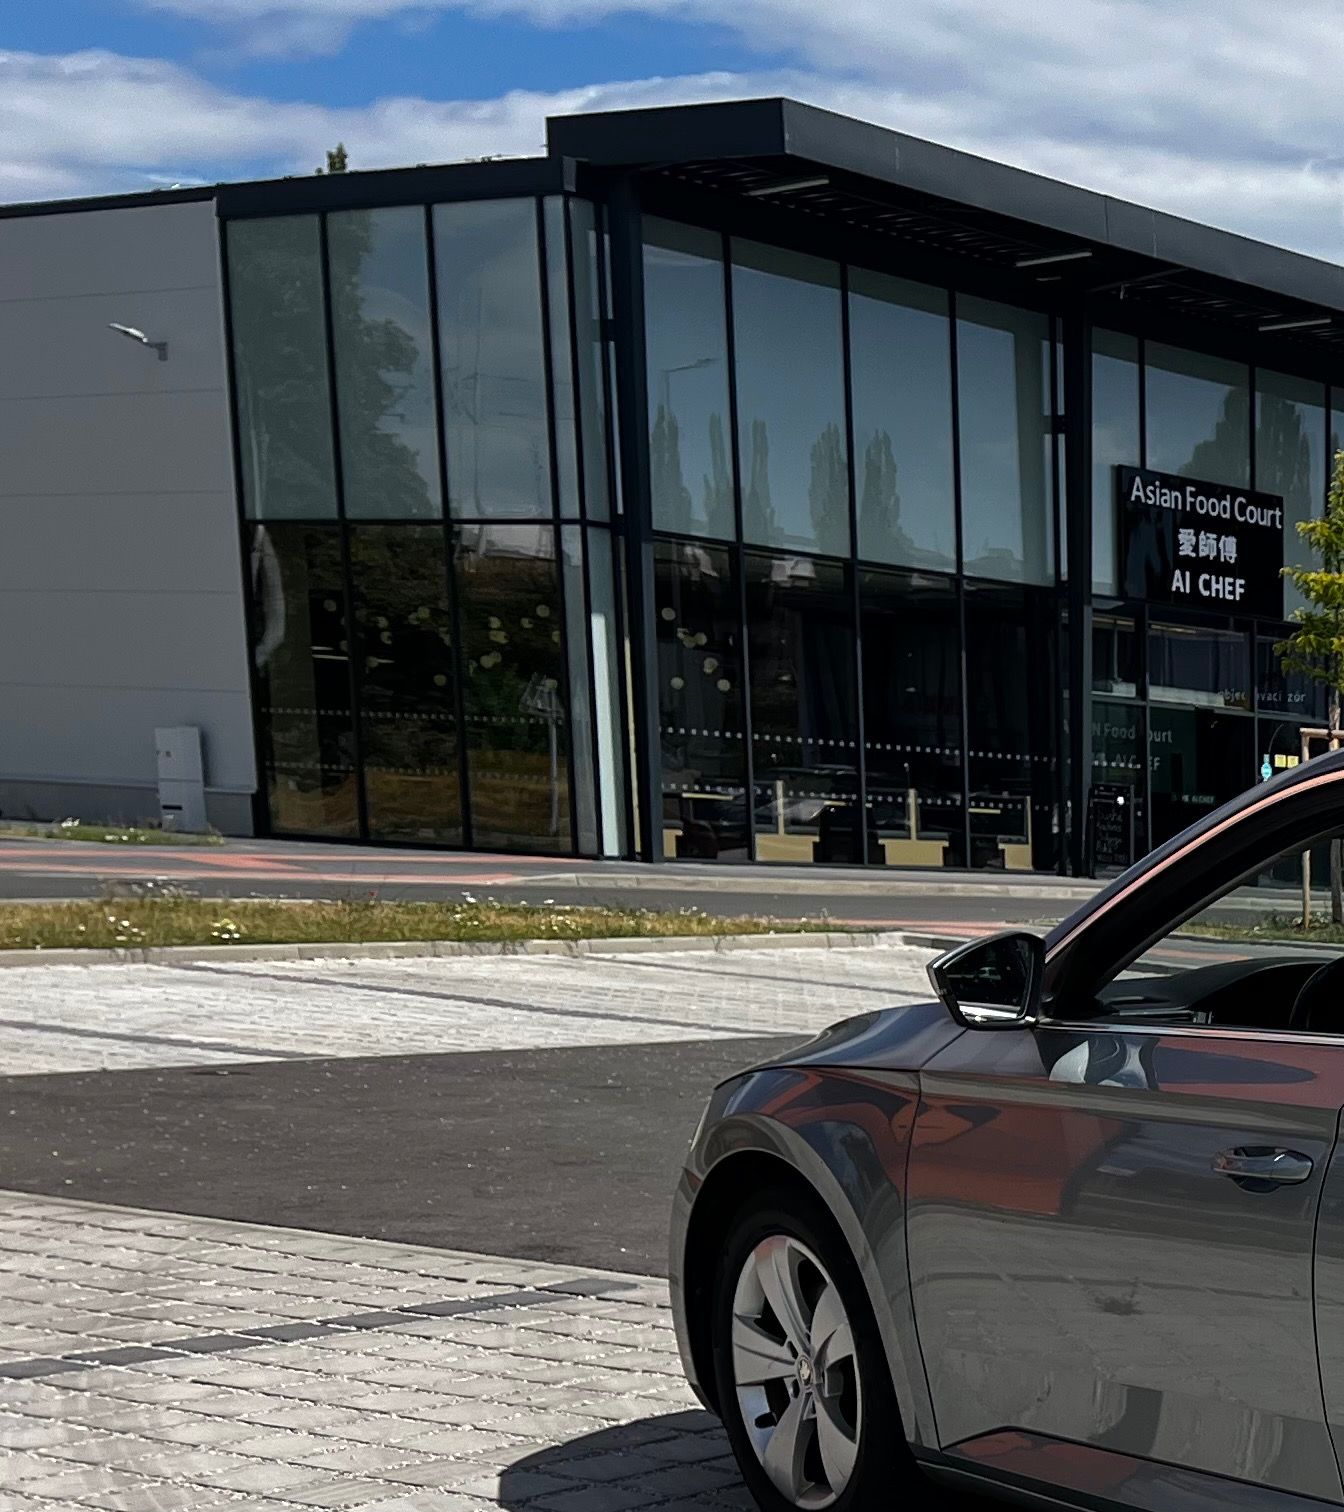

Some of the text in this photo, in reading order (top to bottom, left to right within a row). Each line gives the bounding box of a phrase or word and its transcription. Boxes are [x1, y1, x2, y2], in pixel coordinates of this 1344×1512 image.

[1131, 476, 1282, 529] Asian Food Court
[1171, 569, 1246, 601] AI CHEF
